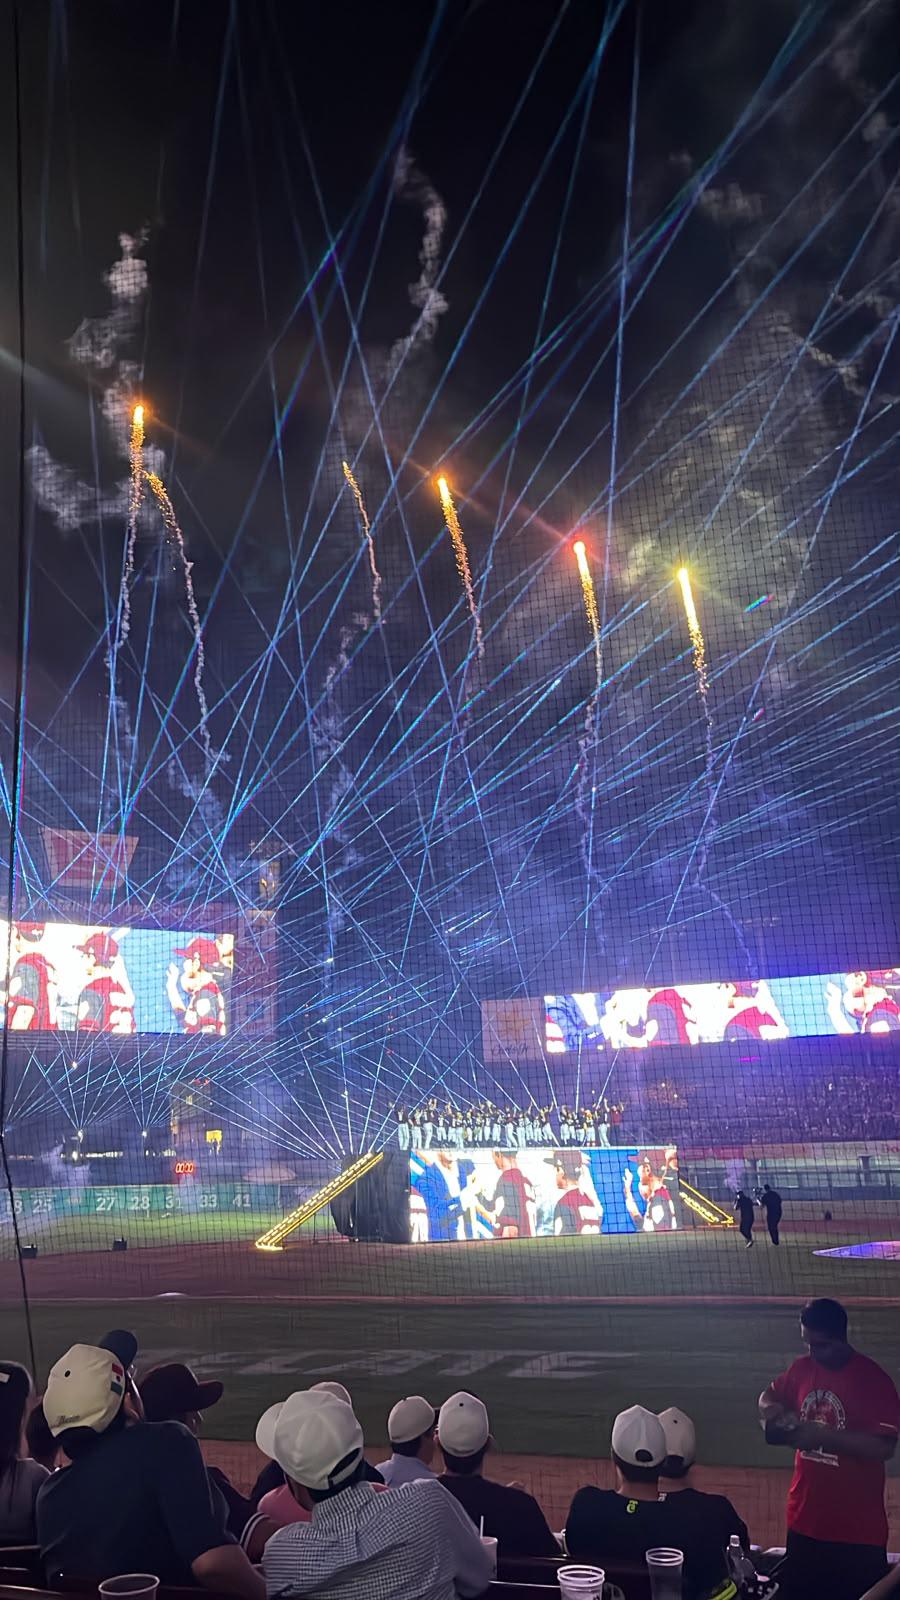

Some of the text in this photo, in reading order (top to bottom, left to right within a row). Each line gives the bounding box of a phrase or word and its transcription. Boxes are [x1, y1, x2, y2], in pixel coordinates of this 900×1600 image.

[32, 1198, 52, 1213] 25
[96, 1196, 116, 1211] 27
[130, 1195, 150, 1210] 28
[200, 1194, 217, 1208] 33
[233, 1193, 251, 1207] 41
